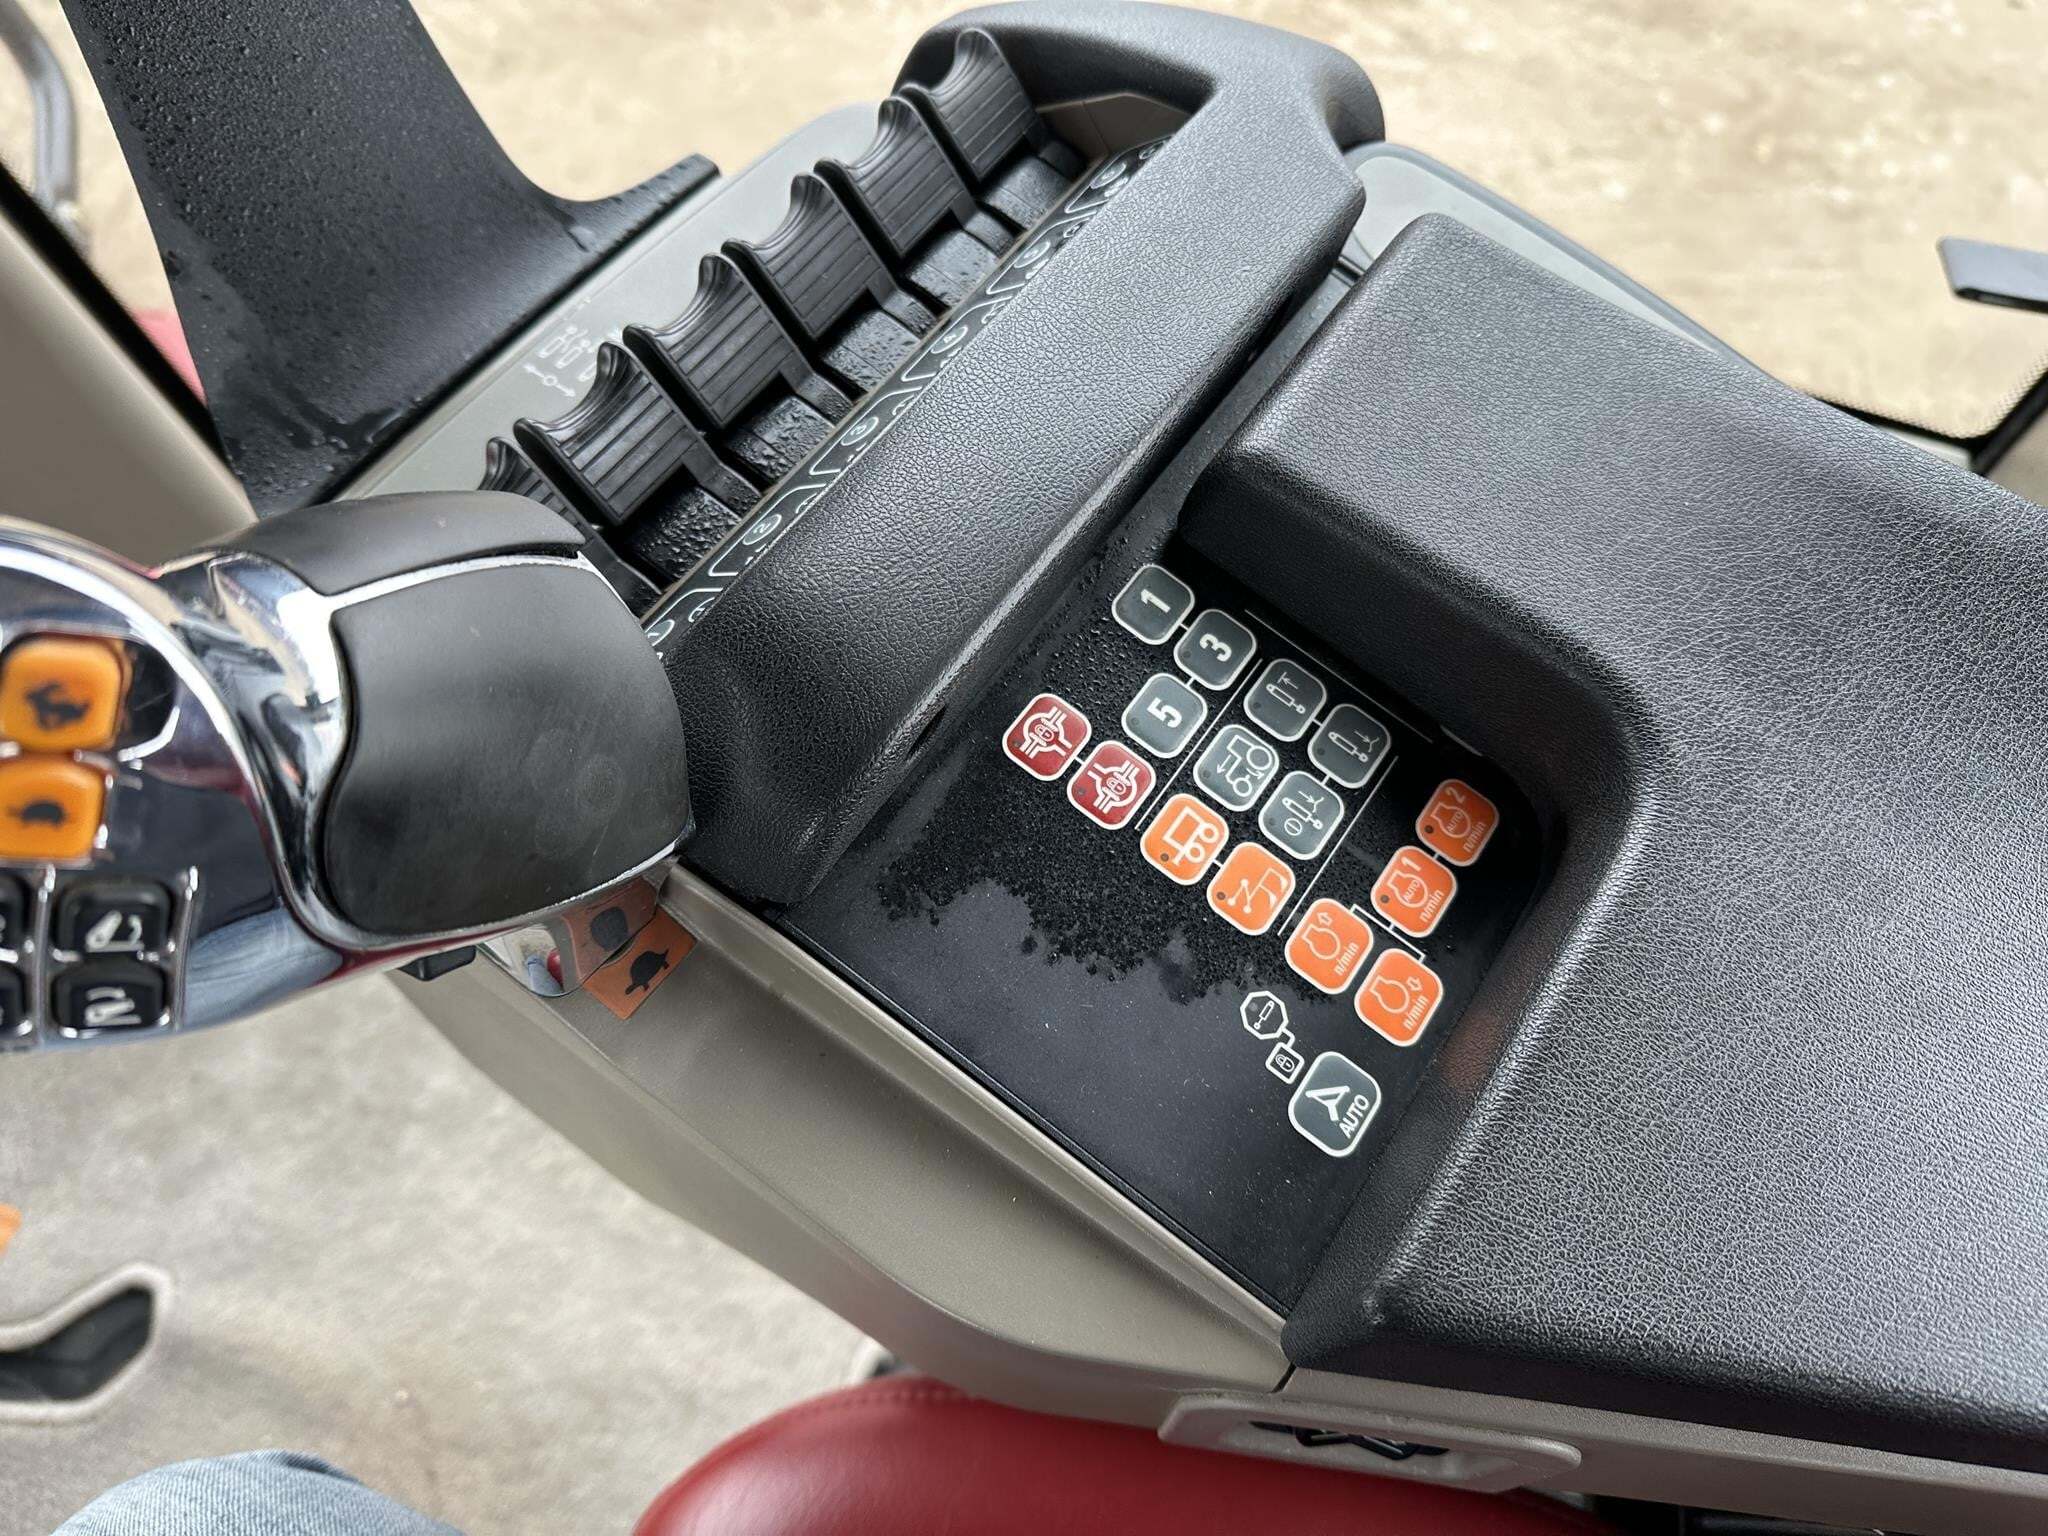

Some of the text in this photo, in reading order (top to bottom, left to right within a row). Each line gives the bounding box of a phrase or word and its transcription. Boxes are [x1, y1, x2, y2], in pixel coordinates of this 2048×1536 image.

[851, 424, 867, 436] 3
[753, 522, 771, 534] 2
[1141, 588, 1171, 613] 1
[1200, 633, 1232, 662] 3
[1147, 696, 1183, 728] 5
[1444, 786, 1467, 805] 2
[1447, 811, 1465, 833] AUTO
[1463, 821, 1486, 853] n/min
[1401, 856, 1422, 872] 1
[1403, 879, 1421, 902] AUTO
[1419, 889, 1444, 923] n/min
[1333, 942, 1359, 976] n/min
[1402, 995, 1430, 1030] n/min
[1338, 1094, 1370, 1139] AUTO
